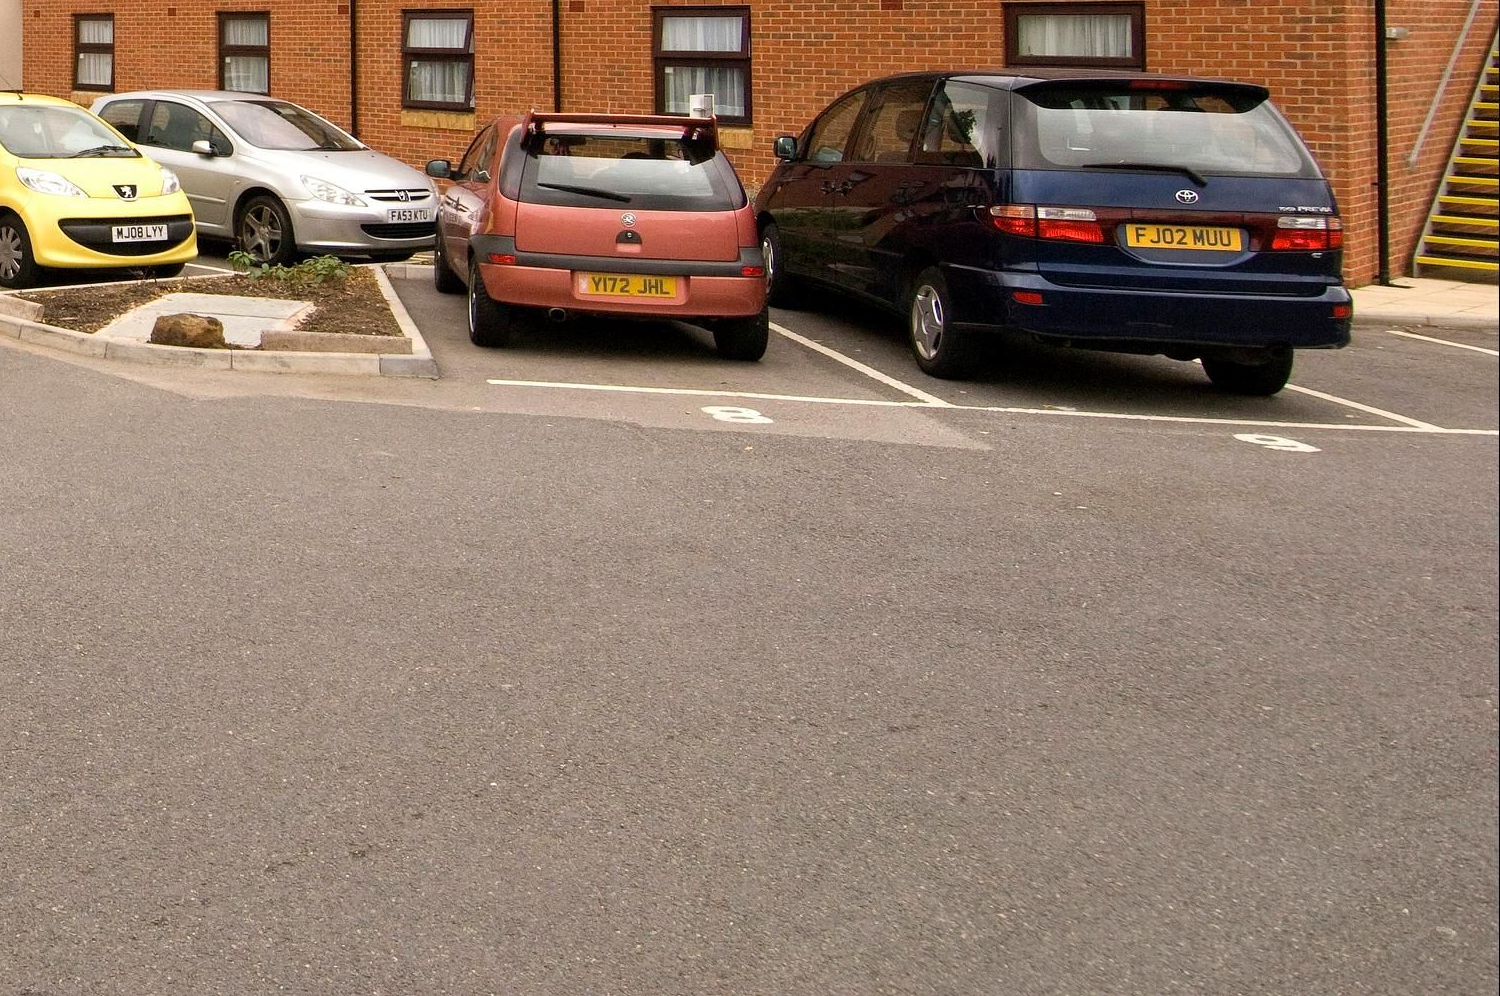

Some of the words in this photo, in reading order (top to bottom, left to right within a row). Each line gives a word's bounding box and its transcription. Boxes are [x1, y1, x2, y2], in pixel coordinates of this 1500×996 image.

[391, 210, 412, 221] FA53
[413, 209, 428, 221] KTU
[116, 226, 144, 240] MJ08
[145, 225, 164, 238] LYY
[1135, 226, 1188, 245] FJ02
[1192, 228, 1232, 247] MUU
[591, 275, 631, 294] Y172
[637, 278, 670, 295] JHL
